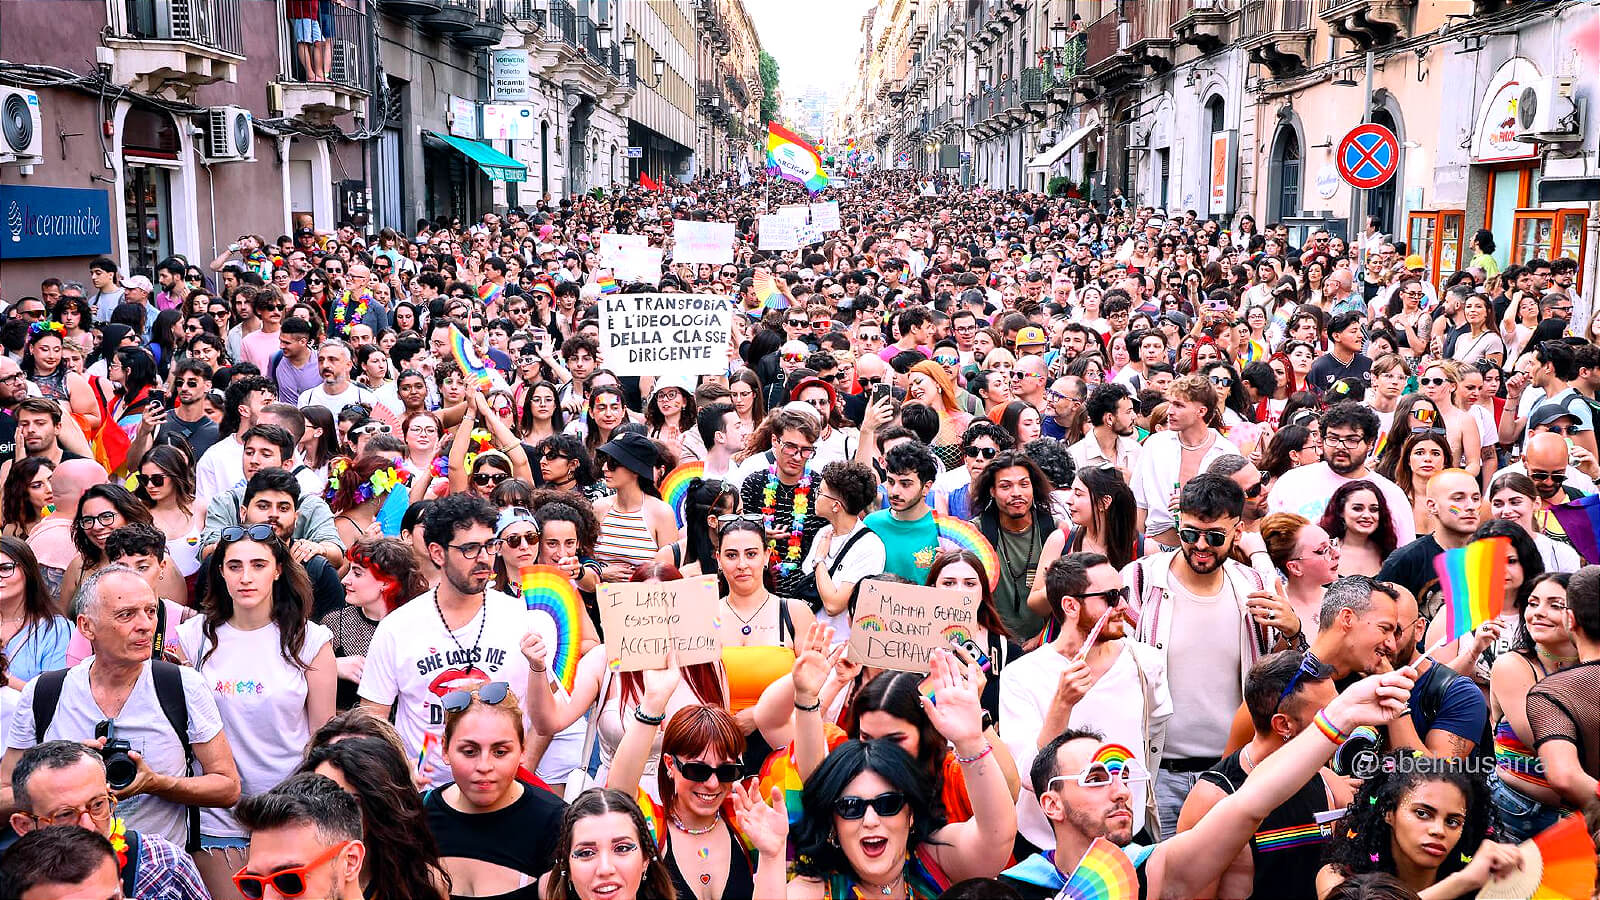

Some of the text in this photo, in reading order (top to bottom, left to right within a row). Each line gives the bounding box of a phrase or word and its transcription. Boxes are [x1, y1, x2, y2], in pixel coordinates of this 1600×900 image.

[778, 158, 810, 176] ARCIGAY
[606, 299, 626, 312] LA
[608, 315, 615, 330] È
[610, 328, 727, 348] DELLA CLASSE
[608, 591, 677, 608] I LARRY
[624, 614, 680, 627] ESISTONO
[934, 606, 972, 623] GUARDA
[867, 636, 952, 664] DEPRAV
[416, 653, 444, 675] SHE
[485, 647, 507, 665] ME
